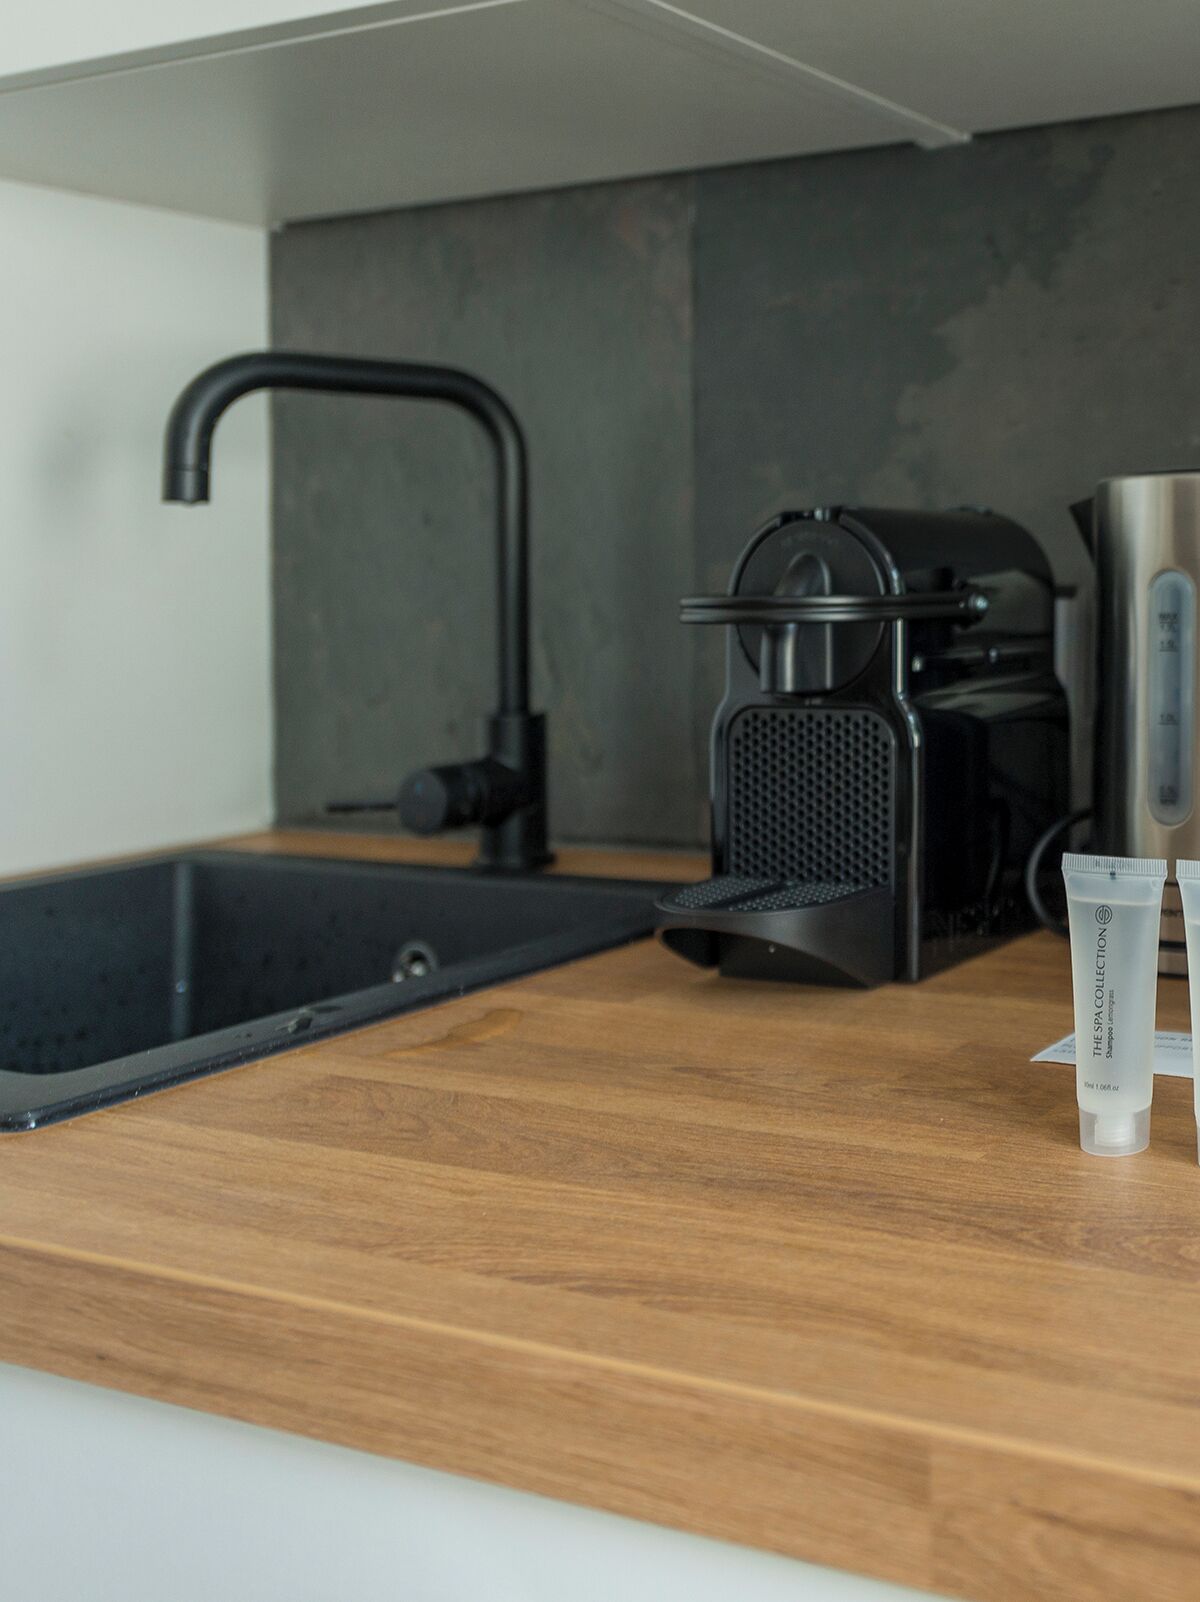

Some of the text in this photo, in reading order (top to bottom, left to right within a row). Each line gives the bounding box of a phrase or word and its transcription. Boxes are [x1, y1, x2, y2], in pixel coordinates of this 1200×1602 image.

[1093, 928, 1108, 1058] THE SPA COLLECTION
[1106, 1026, 1114, 1059] Shampoo
